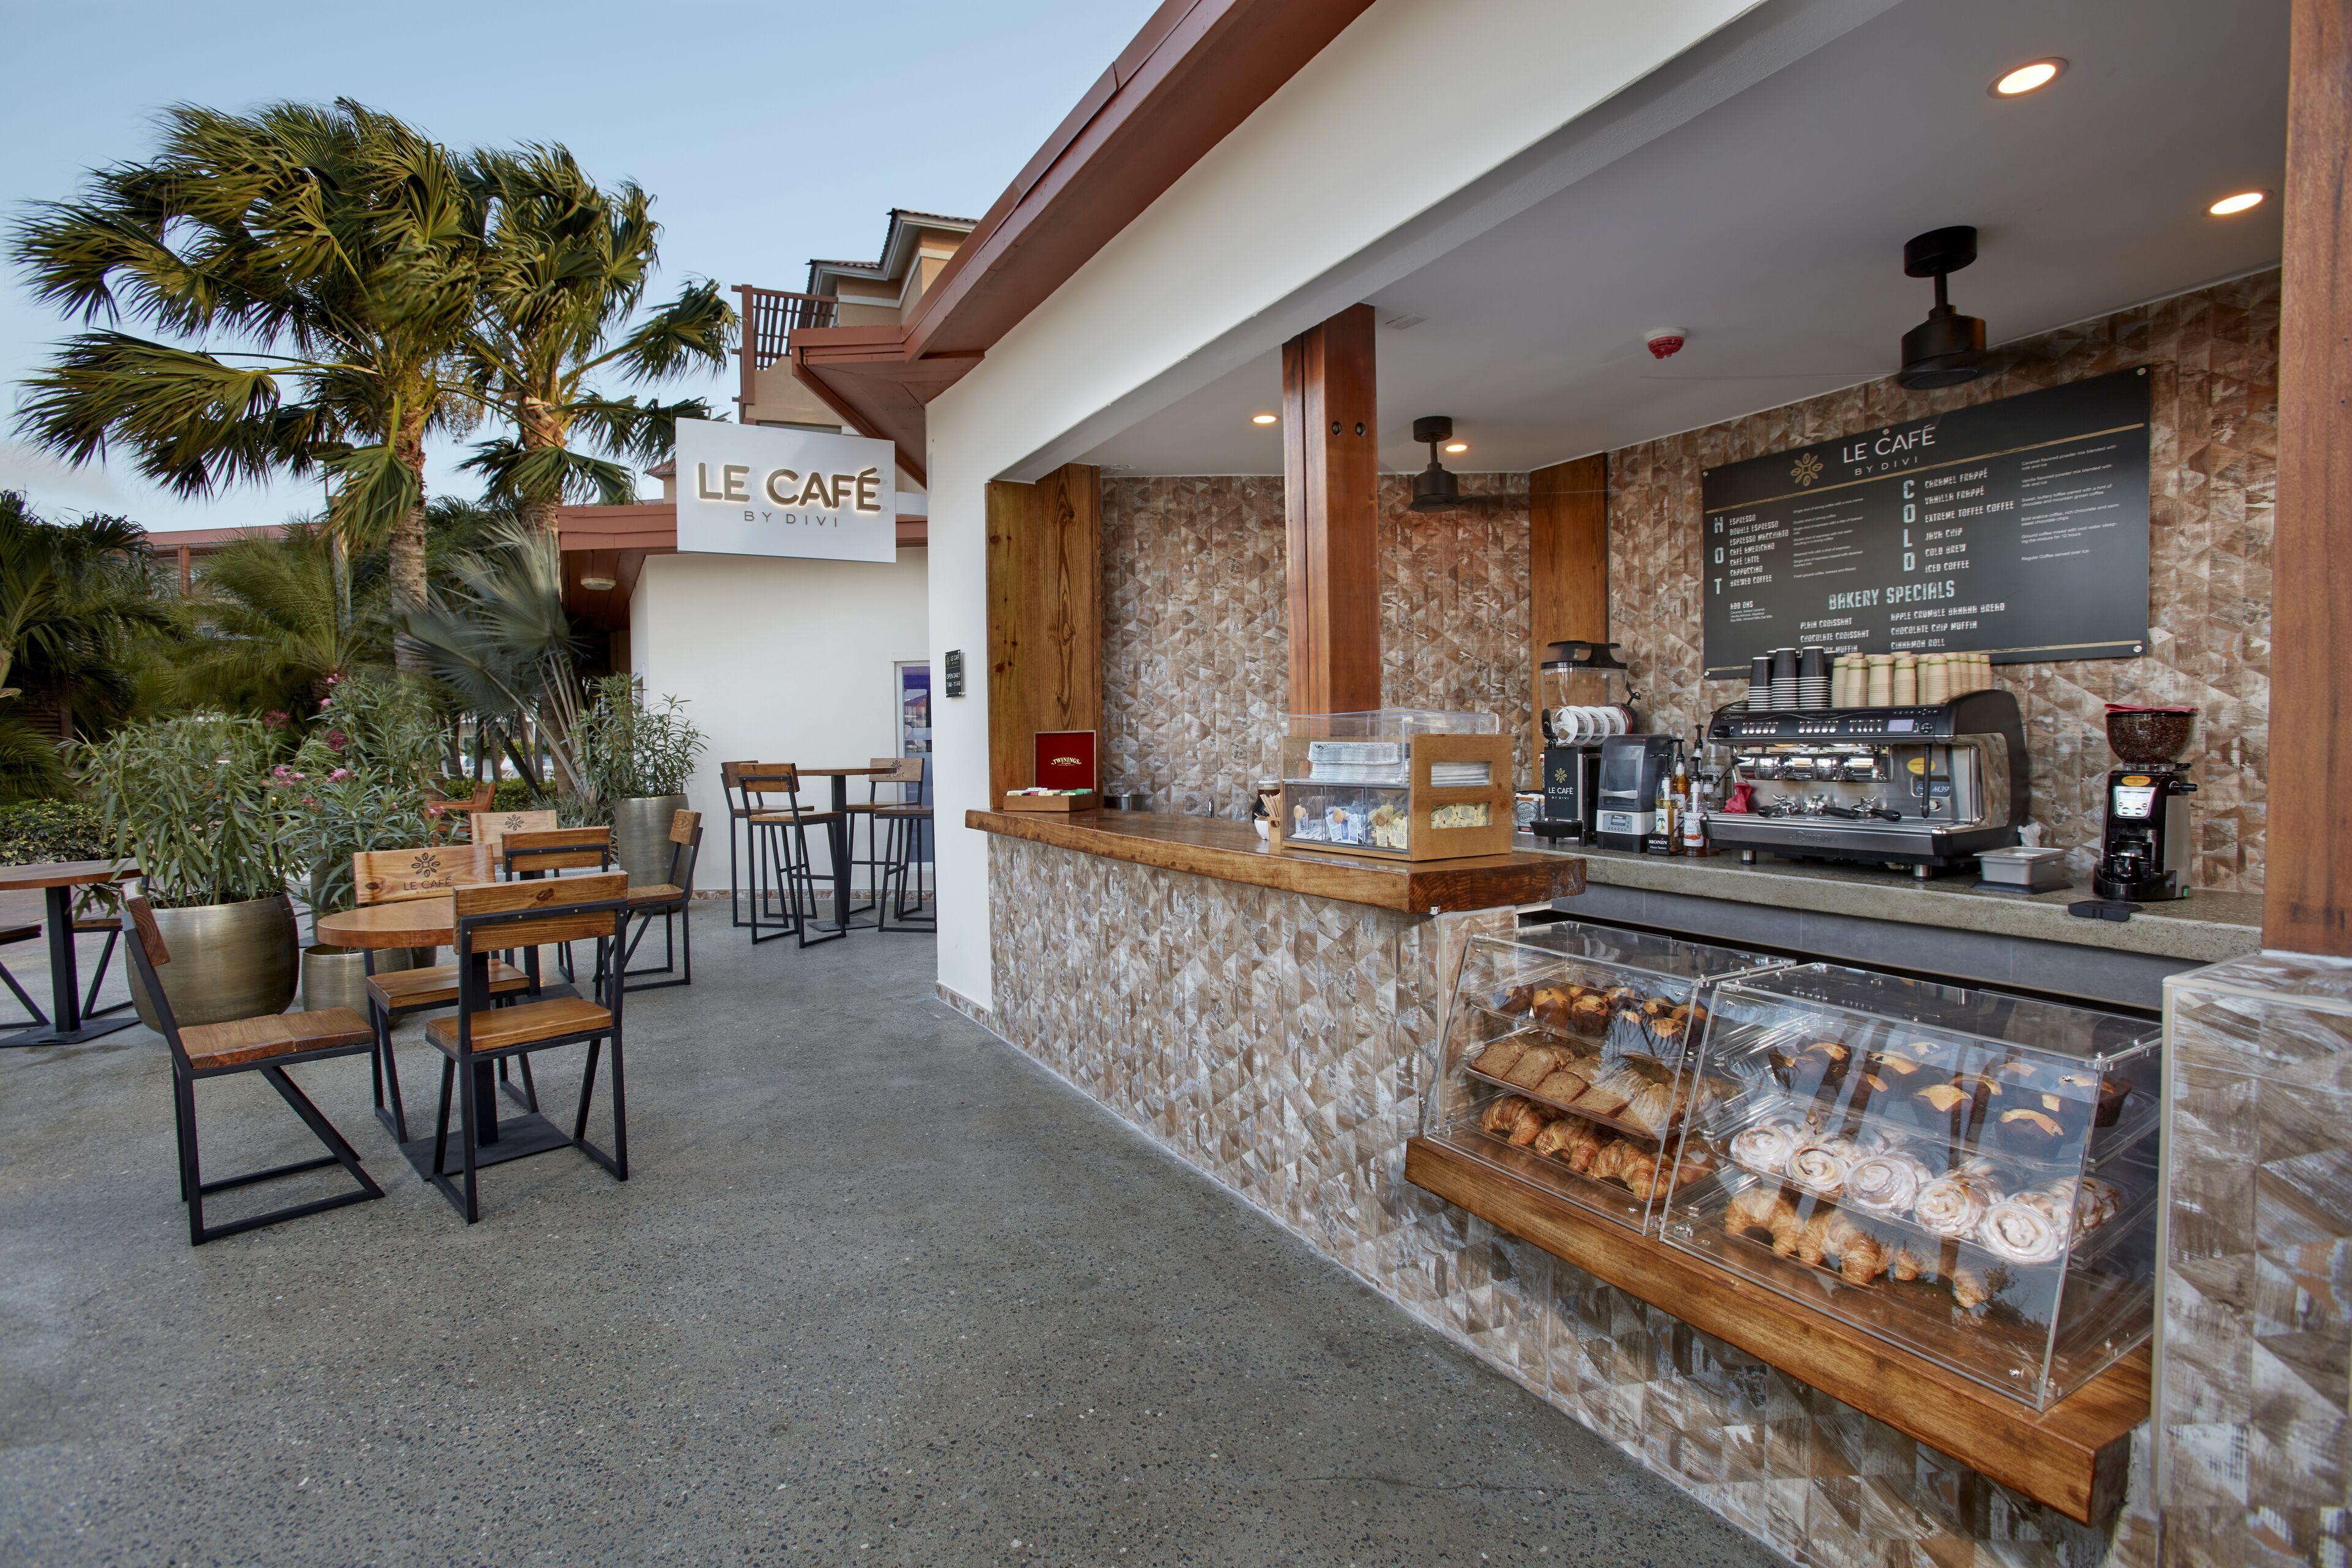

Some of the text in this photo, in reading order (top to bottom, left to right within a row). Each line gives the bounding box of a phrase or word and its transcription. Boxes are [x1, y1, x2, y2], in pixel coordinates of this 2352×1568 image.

[1844, 424, 1936, 463] LE CAFÉ
[1855, 456, 1917, 475] BY DIVI
[1924, 468, 1988, 489] CARAMEL FRAPPÉ
[698, 462, 881, 511] LE CAFÉ
[1924, 485, 1985, 505] VANILLA FRAPPÉ
[1924, 500, 2014, 522] EXTREME TOFFEE COFFEE
[744, 511, 837, 527] BY DIVI
[1730, 514, 1755, 525] ESPRESSO
[1730, 521, 1778, 535] DOUBLE ESPRESSO
[1925, 528, 1962, 540] JAVA CHIP
[1730, 535, 1756, 546] ESPRESSO
[1758, 530, 1789, 541] MACCHIATO
[1730, 543, 1775, 556] CAFÉ AMERICANO
[1925, 544, 1966, 557] COLD BREW
[1730, 556, 1759, 566] CAFÉ LATTE
[1925, 560, 1970, 573] ICED COFFEE
[1730, 565, 1763, 576] CAPPUCCINO
[1730, 575, 1772, 587] BREWED COFFEE
[1829, 580, 1955, 610] BAKERY SPECIALS
[1891, 603, 2005, 621] APPLE CRUMBLE BANANA BREAD
[1819, 617, 1852, 628] CROISSANT
[1891, 620, 1977, 635] CHOCOLATE CHIP MUFFIN
[1800, 630, 1869, 643] CHOCOLATE CROISSANT
[1891, 639, 1926, 649] CINNAMON
[404, 876, 451, 891] LE CAFÉ
